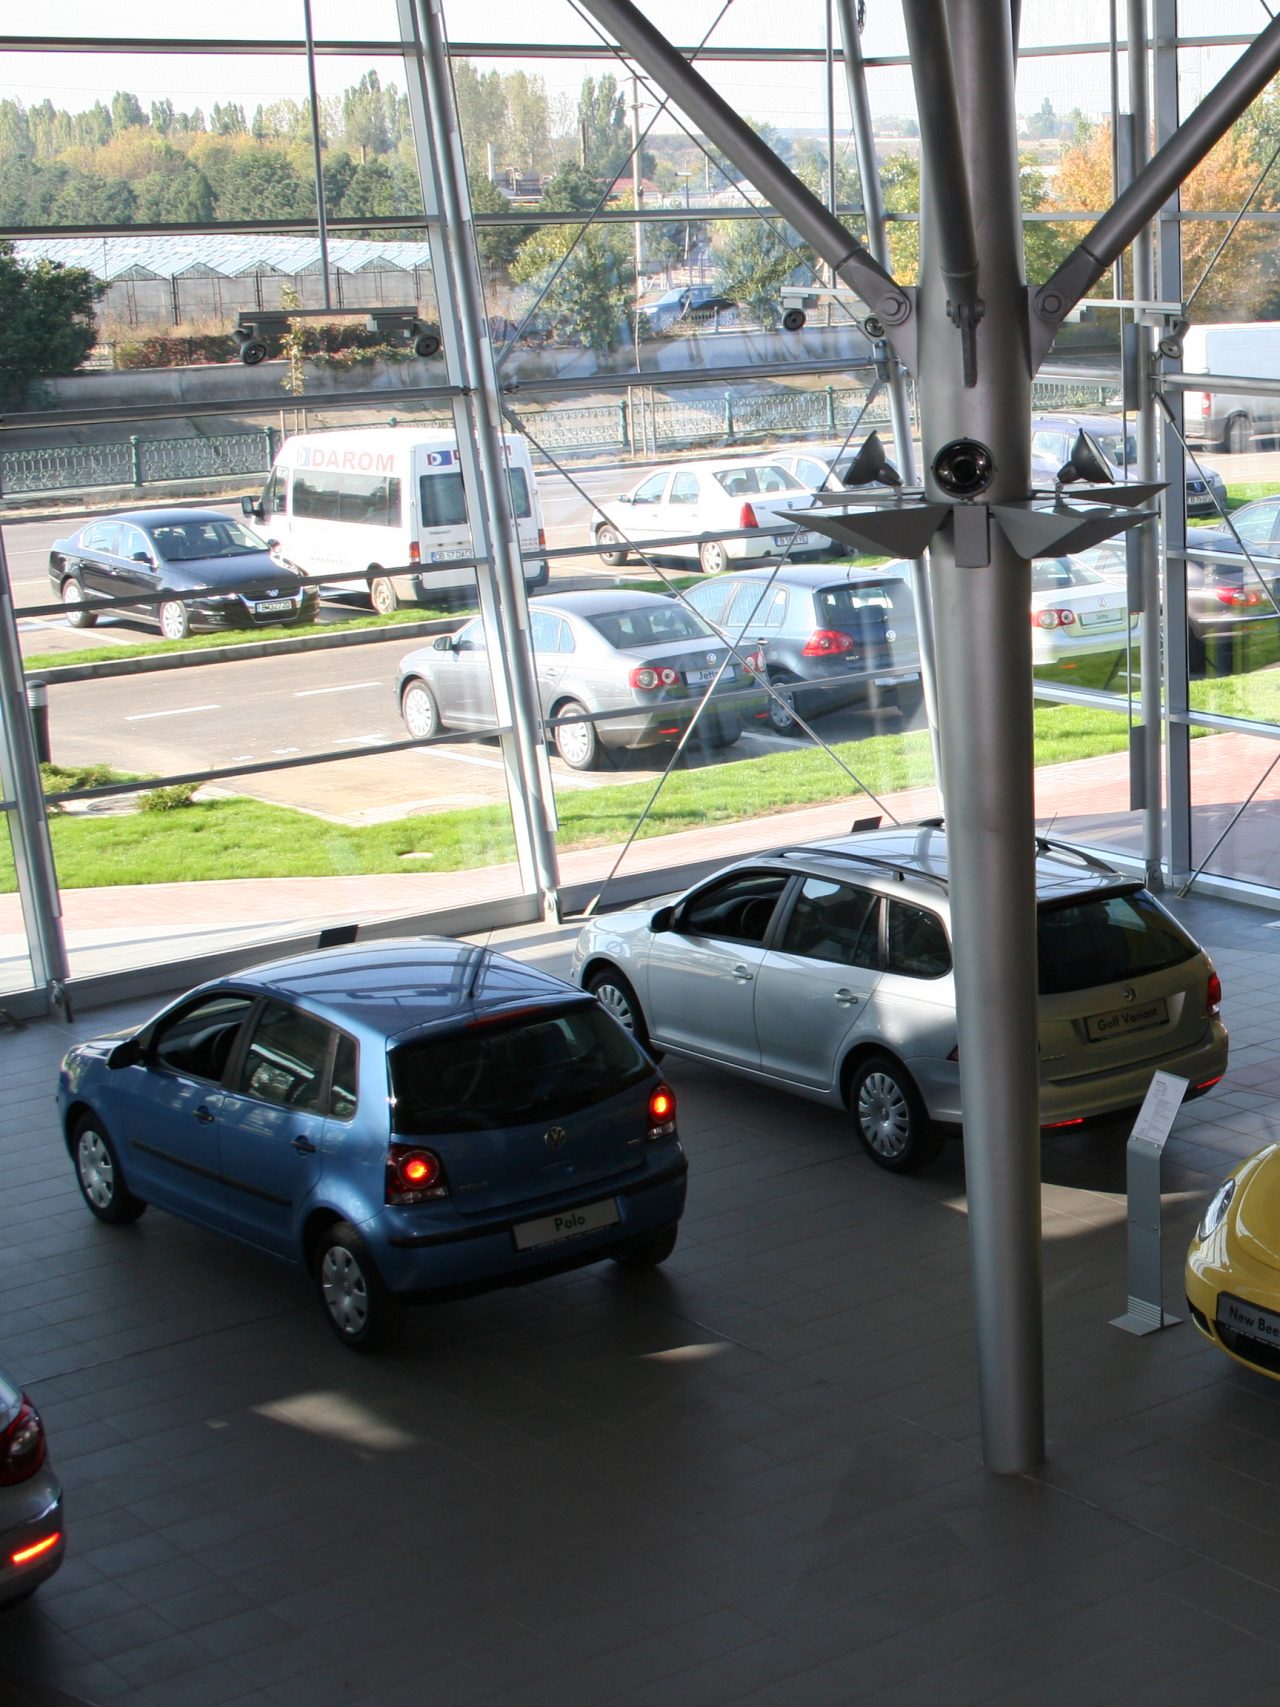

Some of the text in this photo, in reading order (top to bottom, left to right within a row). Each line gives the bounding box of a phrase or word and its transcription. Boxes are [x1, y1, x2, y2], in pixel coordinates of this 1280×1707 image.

[312, 449, 395, 473] DAROM
[1097, 1015, 1120, 1031] Golf
[1121, 1007, 1159, 1024] Variant
[554, 1213, 586, 1232] Polo
[1229, 1305, 1255, 1325] New
